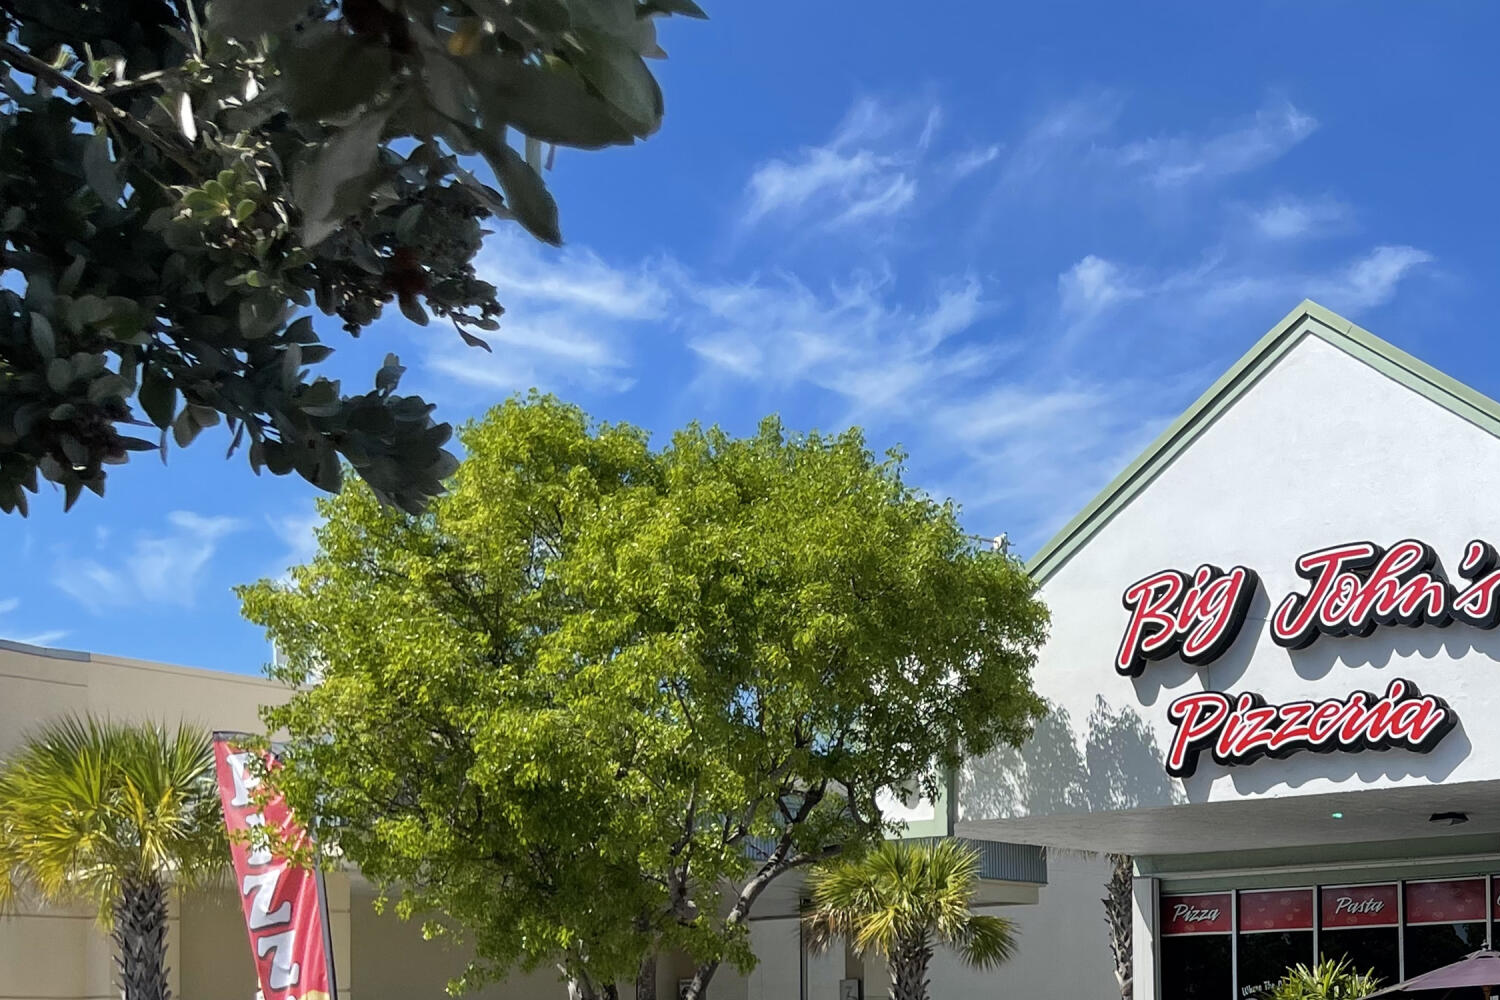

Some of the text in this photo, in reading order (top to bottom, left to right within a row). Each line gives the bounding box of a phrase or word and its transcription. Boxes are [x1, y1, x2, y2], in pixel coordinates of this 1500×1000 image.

[1114, 564, 1258, 677] Big
[1165, 677, 1457, 779] Pizzeria
[1172, 903, 1220, 923] Pizza
[1335, 896, 1384, 914] Pasta
